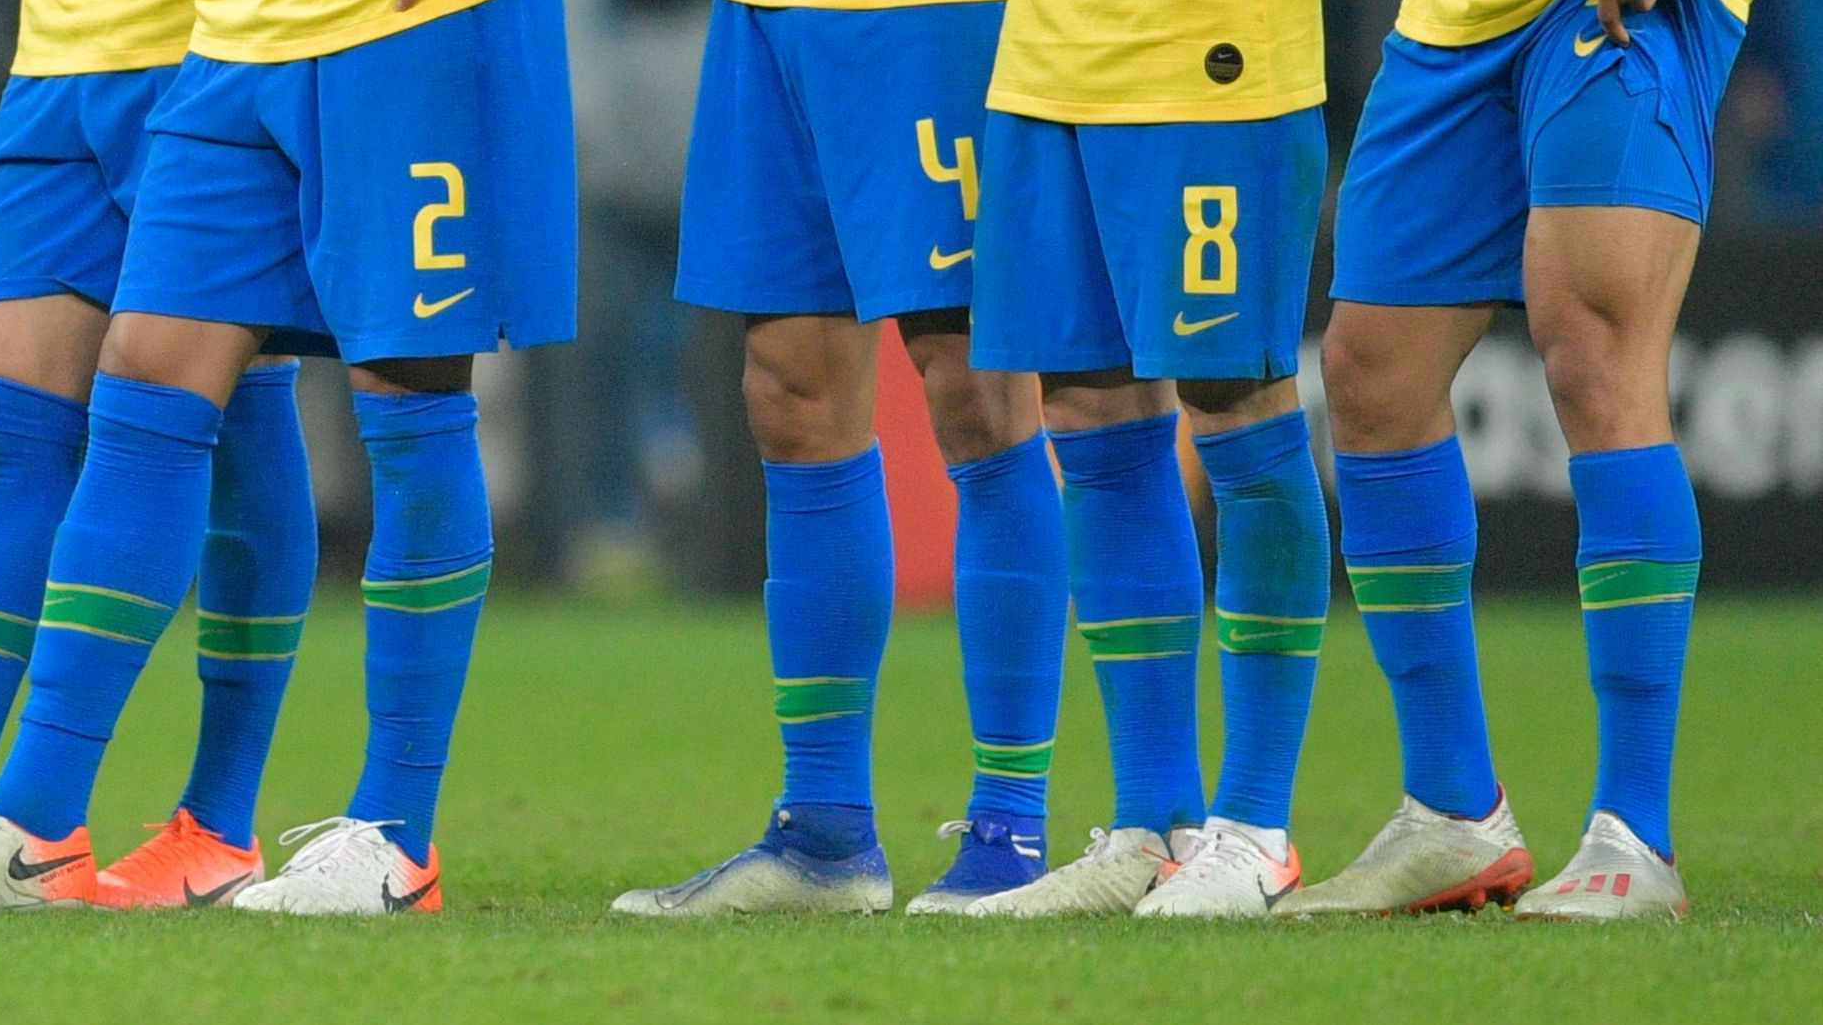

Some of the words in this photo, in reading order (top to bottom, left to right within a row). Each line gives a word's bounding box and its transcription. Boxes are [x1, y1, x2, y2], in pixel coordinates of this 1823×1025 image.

[409, 161, 467, 270] 2
[915, 118, 979, 221] 4
[1182, 185, 1240, 295] 8
